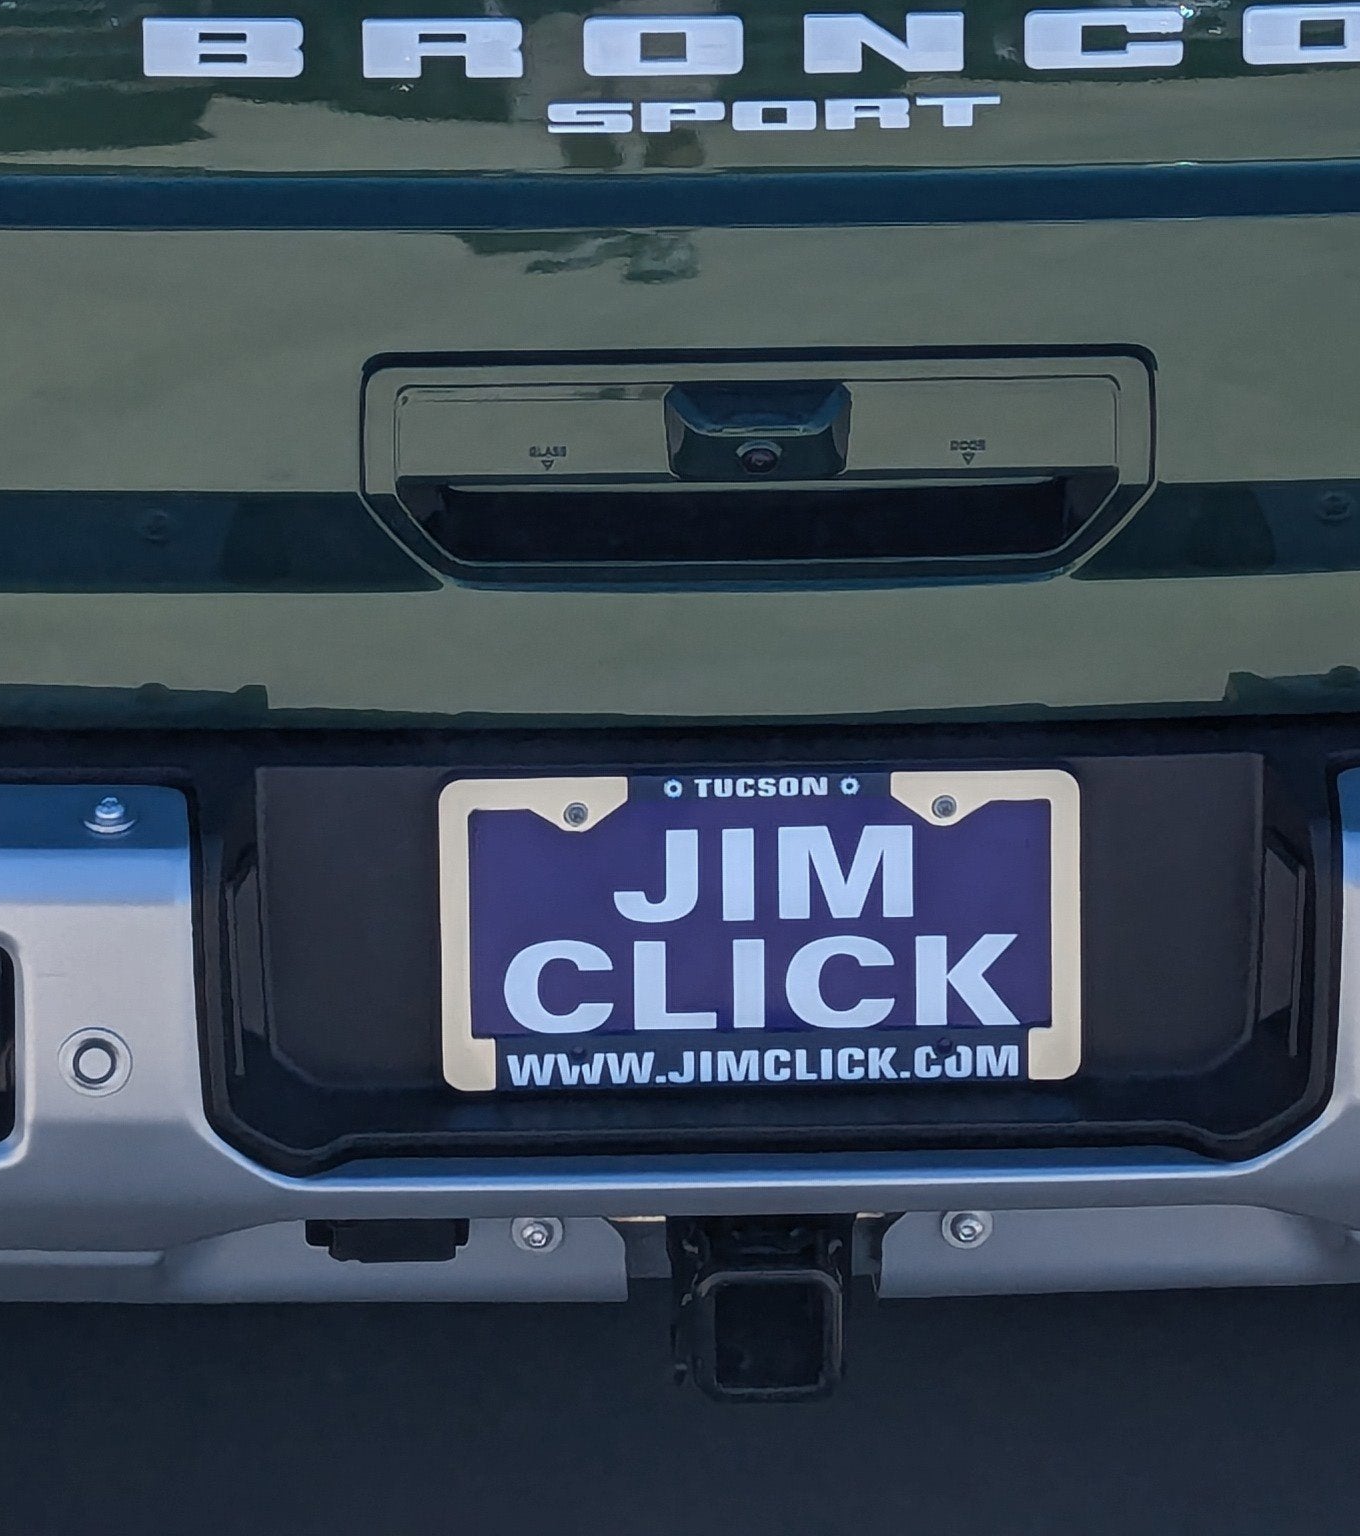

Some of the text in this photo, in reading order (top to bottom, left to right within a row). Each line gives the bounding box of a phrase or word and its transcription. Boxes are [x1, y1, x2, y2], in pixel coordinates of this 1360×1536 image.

[547, 95, 1001, 133] SPORT
[694, 777, 828, 798] TUCSON
[613, 825, 914, 923] JIM
[503, 933, 1020, 1034] CLICK
[506, 1045, 1019, 1086] WWW.JIMCLICK.COM
